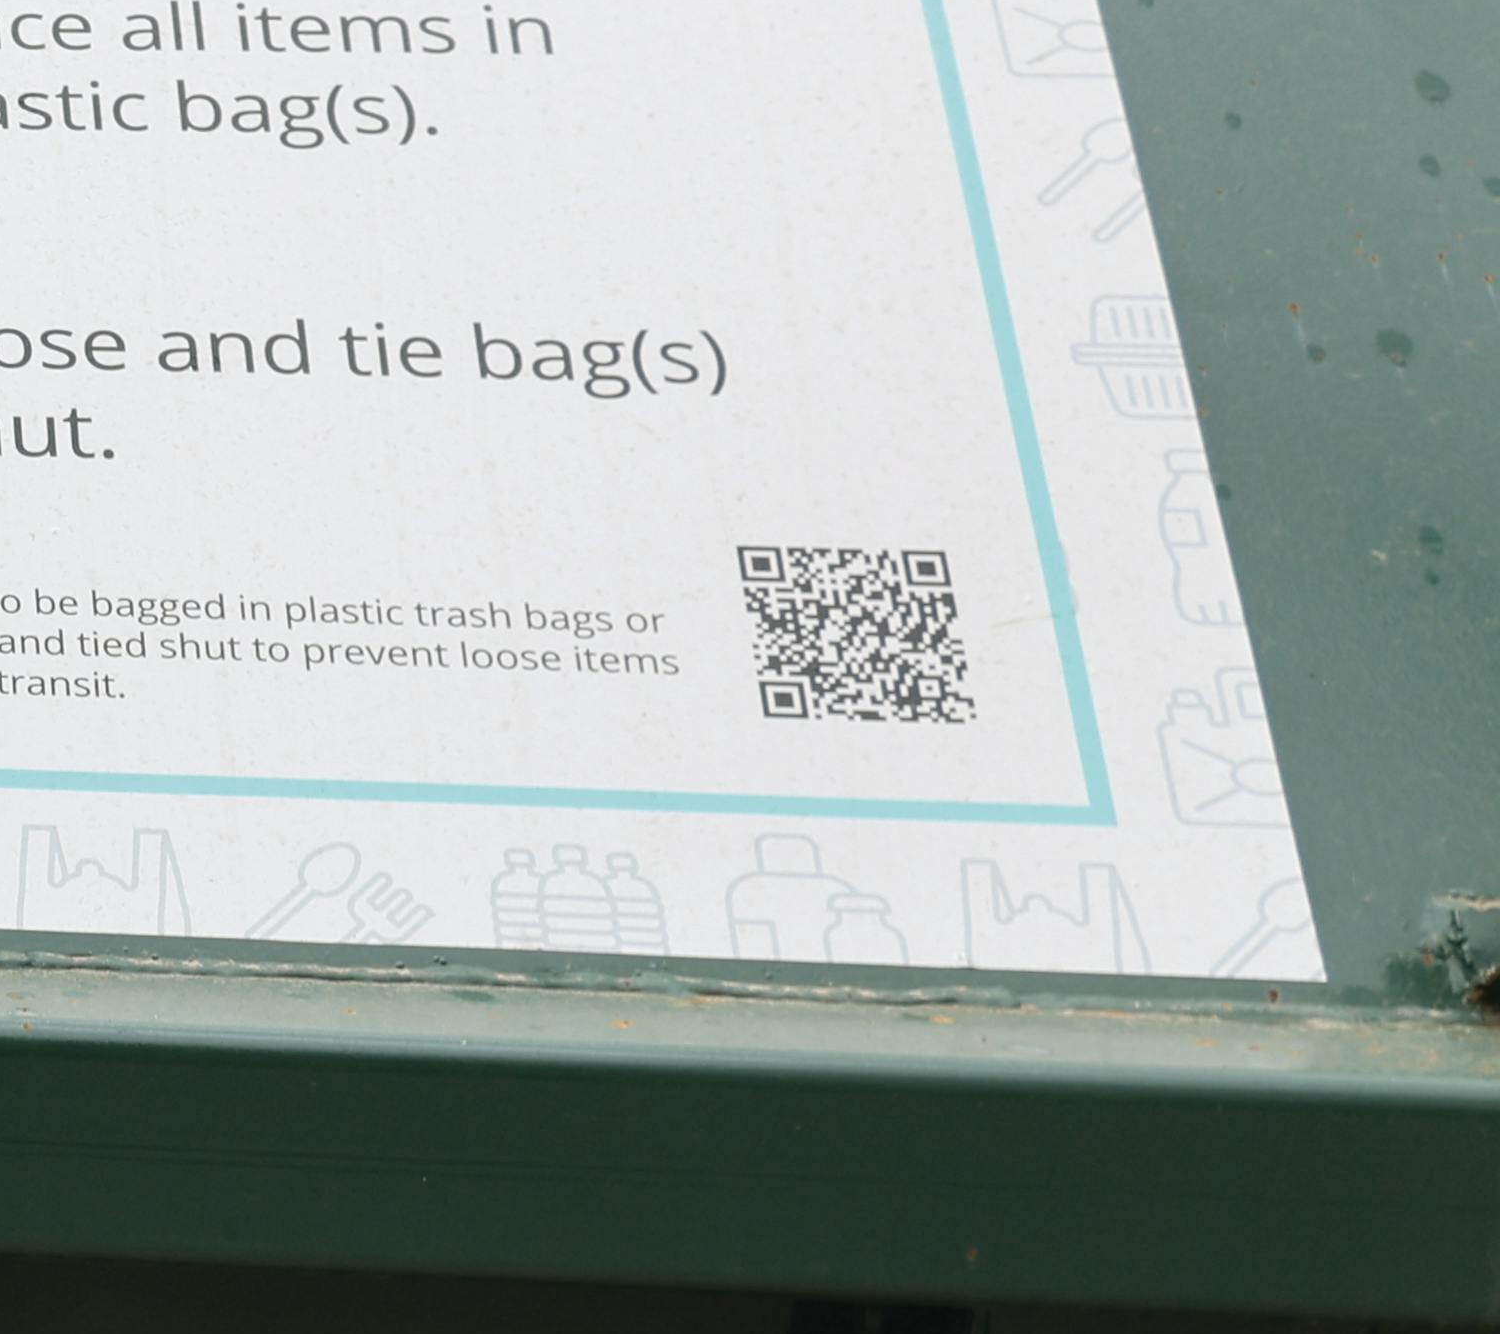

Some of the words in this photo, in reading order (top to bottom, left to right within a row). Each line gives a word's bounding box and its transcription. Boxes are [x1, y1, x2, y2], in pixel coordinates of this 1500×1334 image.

[123, 1, 204, 51] all
[237, 3, 455, 53] items
[484, 5, 553, 54] in
[177, 80, 437, 149] bag(s).
[158, 319, 310, 374] and
[339, 322, 442, 377] tie
[473, 323, 726, 399] bag(s)
[35, 587, 79, 616] be
[91, 588, 225, 627] bagged
[240, 595, 271, 621] in
[285, 597, 403, 629] plastic
[414, 601, 511, 629] trash
[525, 602, 613, 640] bags
[626, 610, 665, 635] or
[76, 631, 146, 658] tied
[160, 633, 241, 662] shut
[252, 638, 290, 663] to
[303, 641, 449, 670] prevent
[461, 641, 561, 672] loose
[574, 646, 679, 675] items
